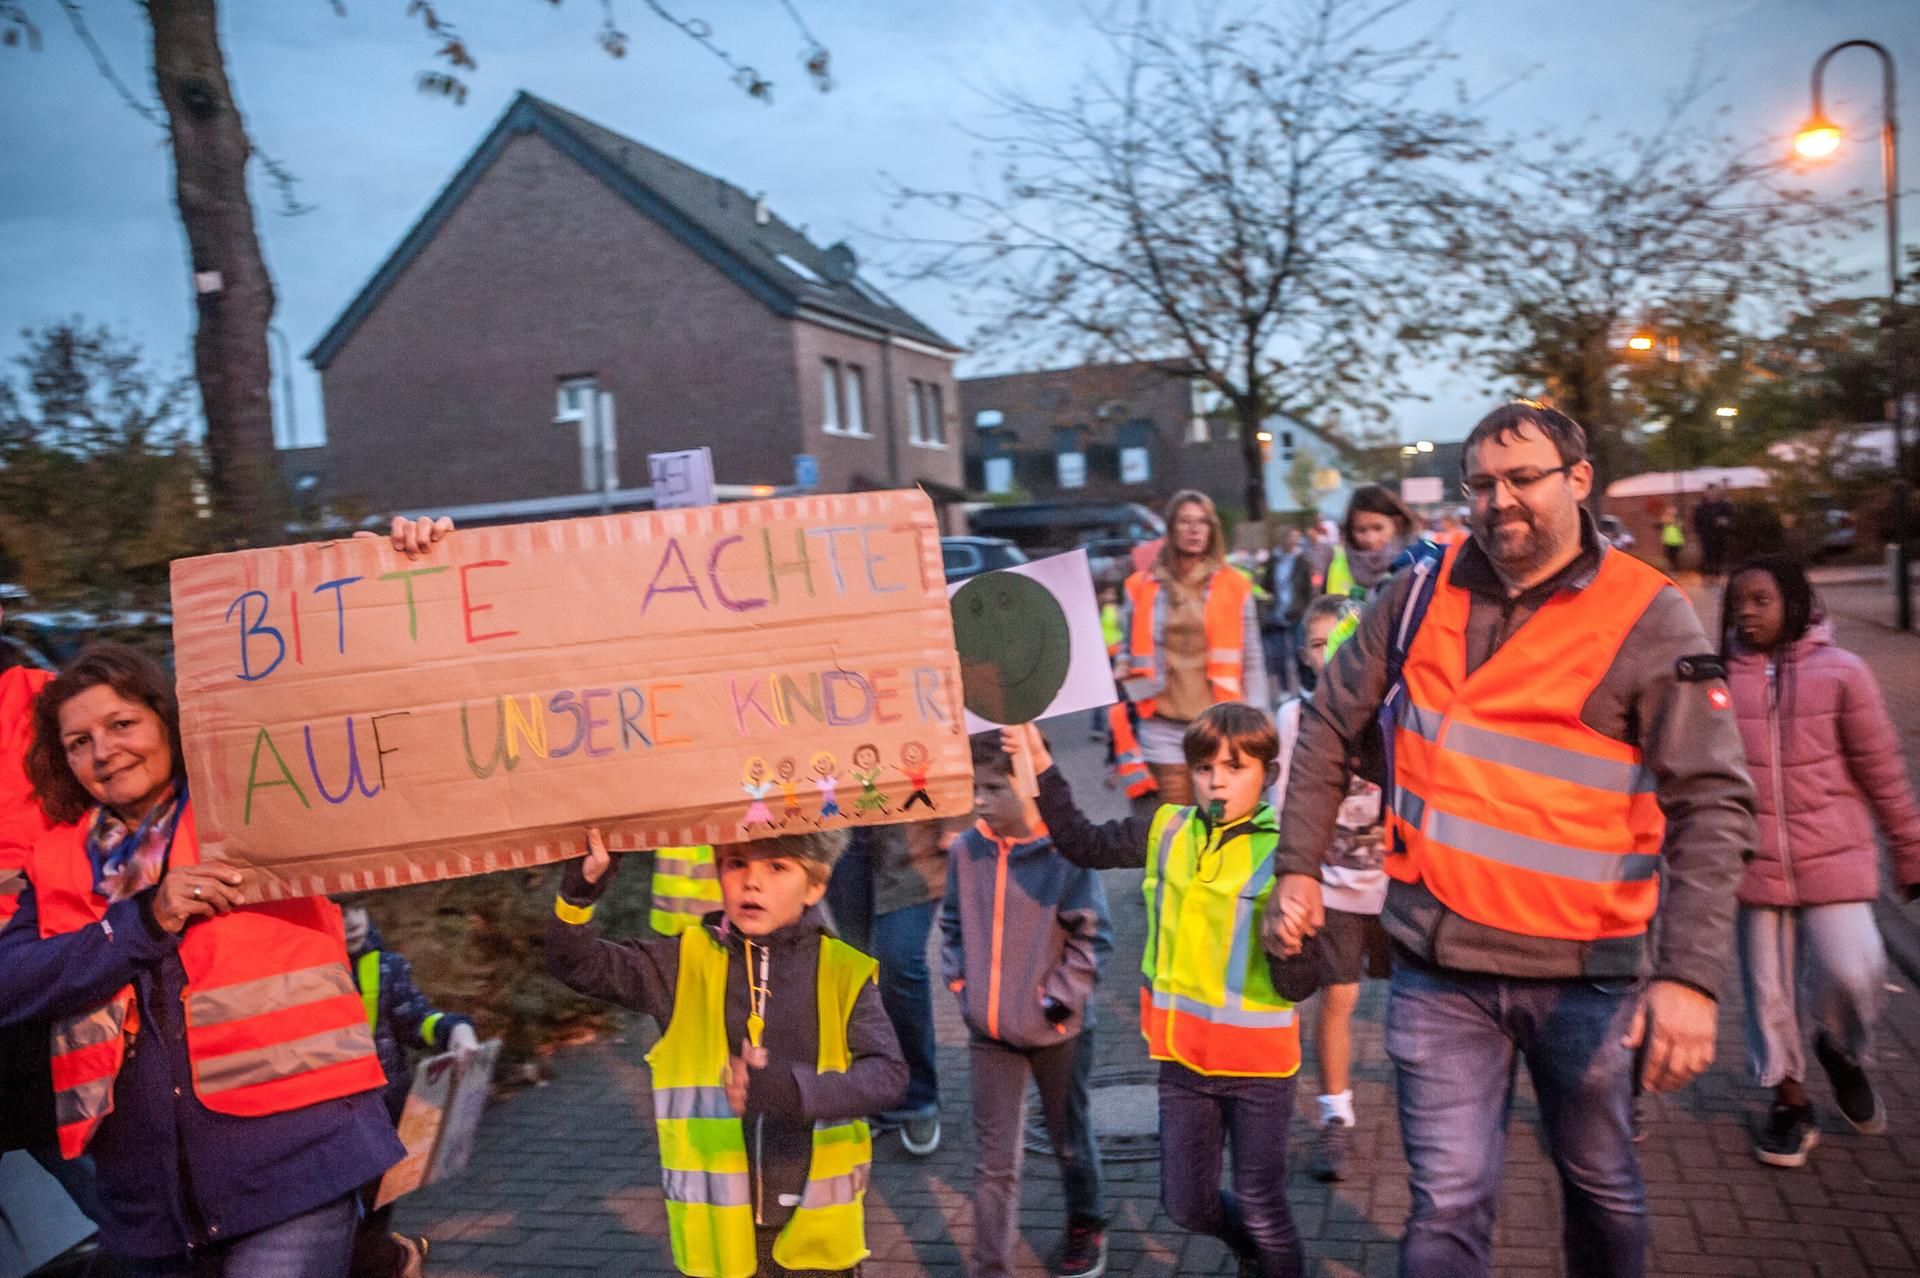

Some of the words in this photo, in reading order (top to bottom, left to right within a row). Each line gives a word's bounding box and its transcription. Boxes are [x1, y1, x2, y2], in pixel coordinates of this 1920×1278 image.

[225, 559, 520, 681] BITTE
[640, 521, 938, 617] ACHTET
[243, 710, 411, 826] AUF
[460, 682, 695, 780] UNSERE
[728, 666, 961, 738] KINDER!
